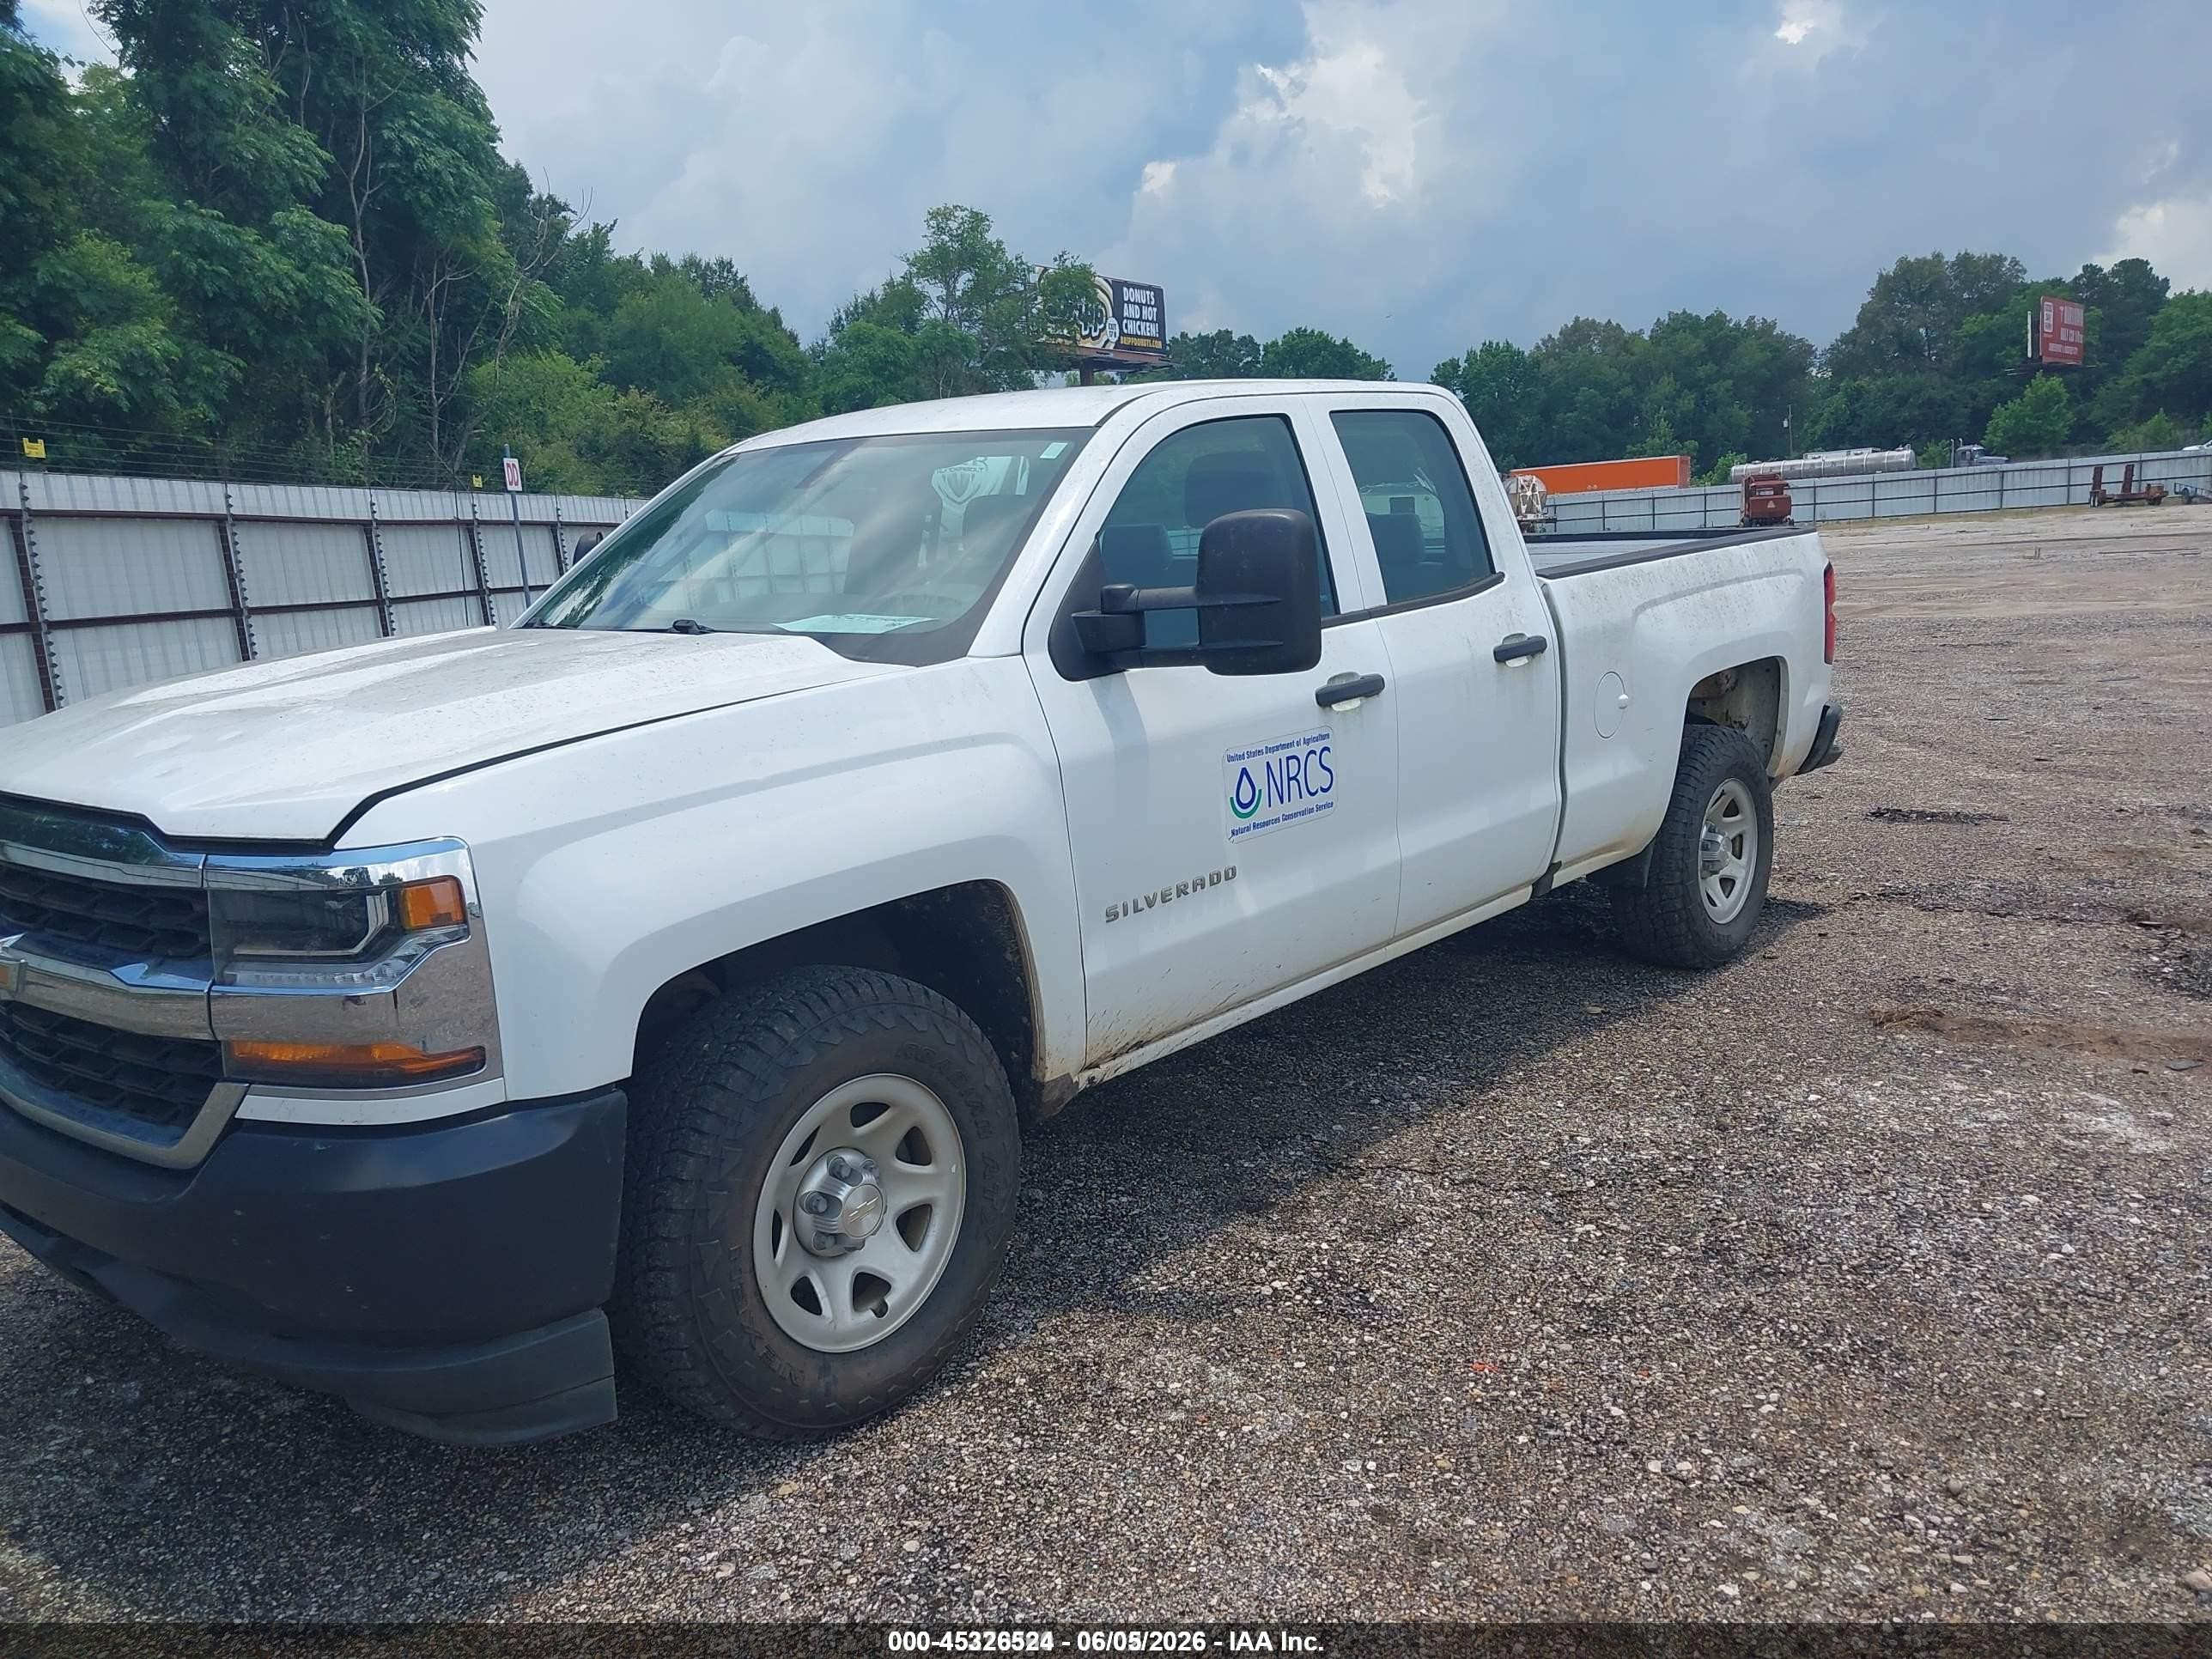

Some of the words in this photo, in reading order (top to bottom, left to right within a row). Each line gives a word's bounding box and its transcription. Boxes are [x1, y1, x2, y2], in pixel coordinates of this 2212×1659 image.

[1122, 286, 1155, 305] DONUTS
[1123, 303, 1140, 319] AND
[1141, 306, 1158, 321] HOT
[1122, 319, 1159, 337] CHICKEN!
[506, 462, 520, 486] DD
[1226, 752, 1246, 763] United
[1246, 748, 1265, 759] States
[1265, 740, 1296, 755] Department
[1296, 738, 1302, 748] of
[1303, 732, 1330, 746] Agriculture
[1265, 745, 1334, 808] NRCS
[1231, 823, 1252, 837] Natural
[1252, 816, 1281, 830] Resources
[1281, 806, 1315, 821] Conservation
[1315, 800, 1334, 813] Service
[1105, 865, 1237, 923] SILVERADO
